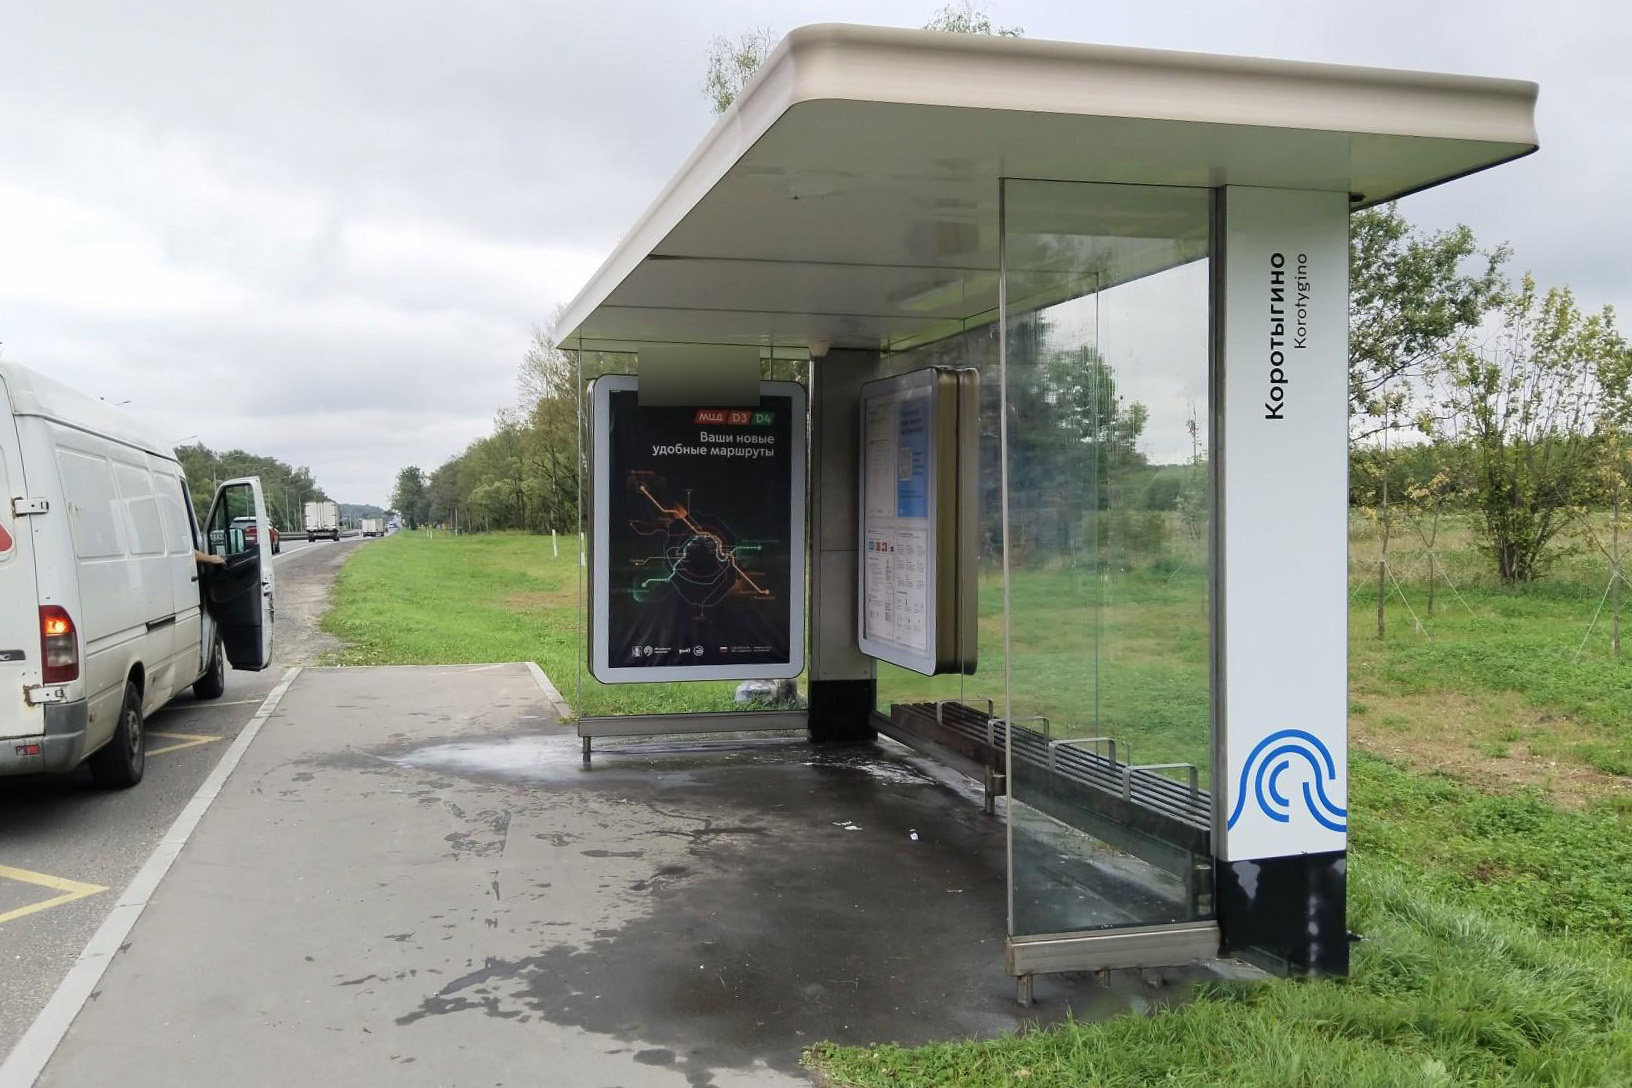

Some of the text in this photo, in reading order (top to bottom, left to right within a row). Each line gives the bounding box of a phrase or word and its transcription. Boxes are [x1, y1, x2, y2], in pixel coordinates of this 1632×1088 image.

[1294, 253, 1311, 349] Korotygino
[1265, 252, 1288, 419] Коротыгино
[699, 412, 771, 423] МЦД D3 D4
[700, 431, 775, 444] Ваши новые
[652, 443, 774, 459] удобные маршруты
